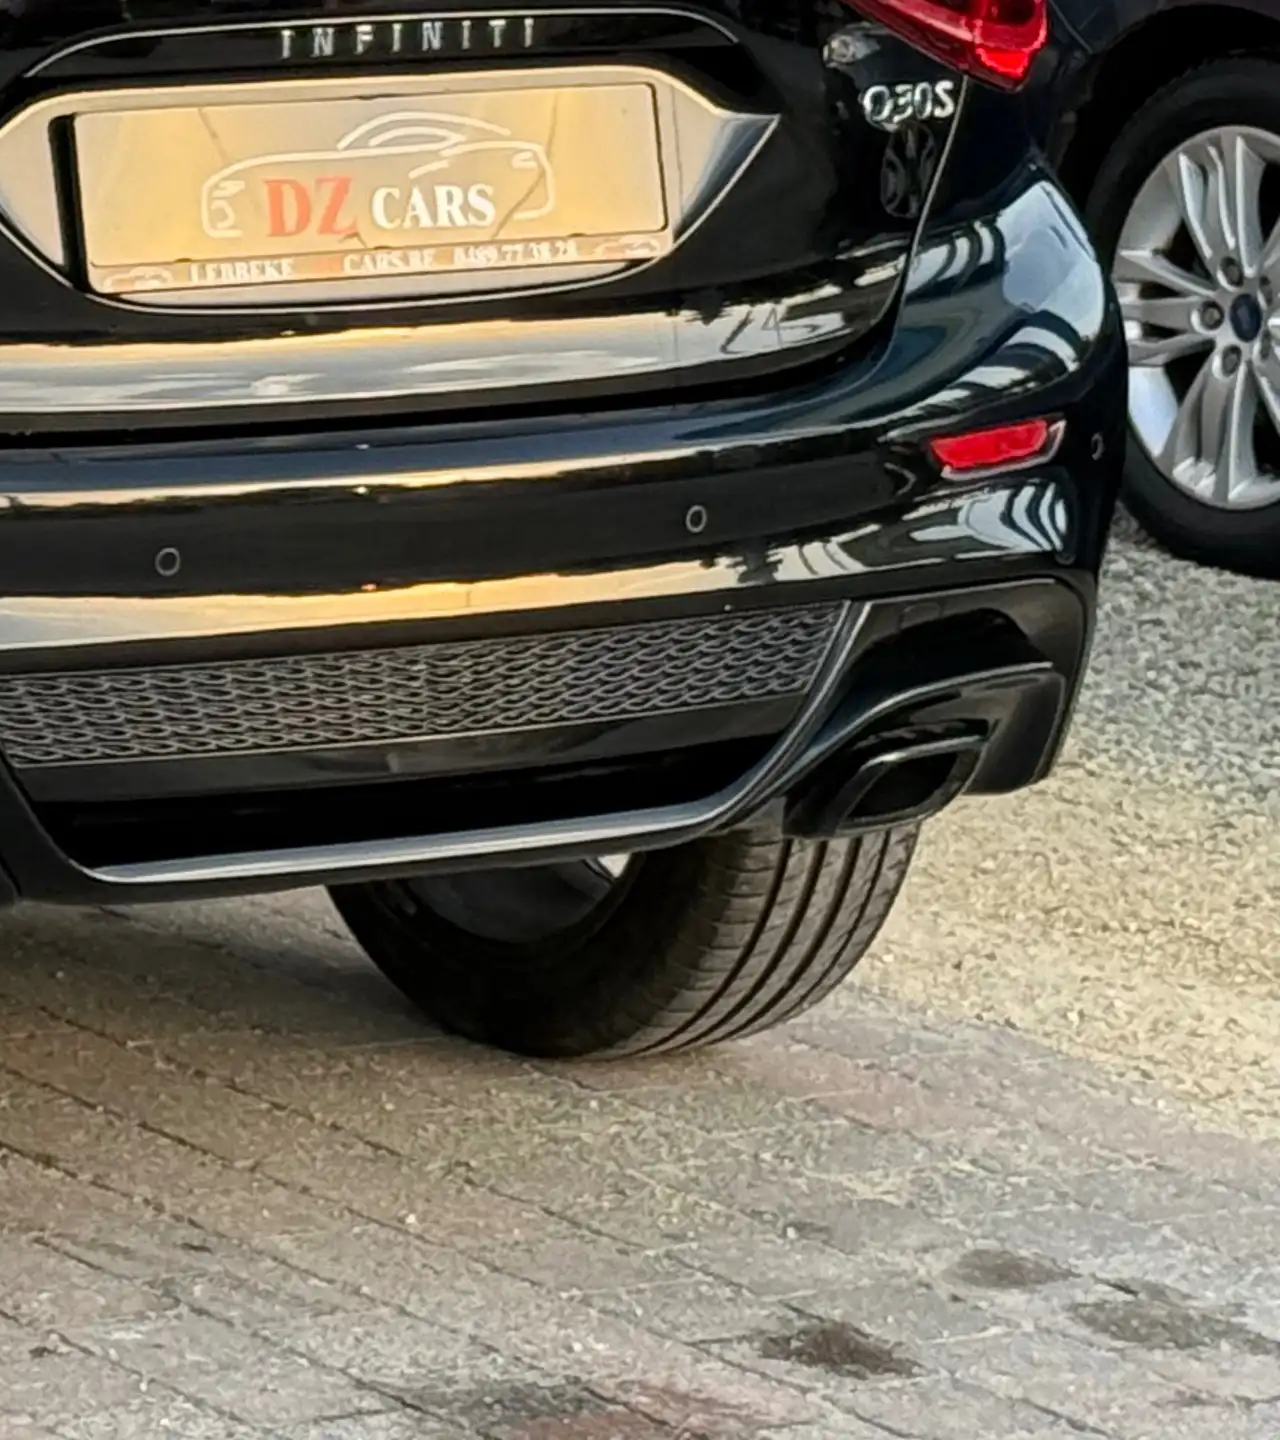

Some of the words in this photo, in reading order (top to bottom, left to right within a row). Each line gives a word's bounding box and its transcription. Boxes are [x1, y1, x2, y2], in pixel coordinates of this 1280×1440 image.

[280, 17, 535, 59] INFINITI
[862, 79, 955, 133] Q30S
[261, 173, 358, 238] DZ
[371, 182, 497, 230] CARS
